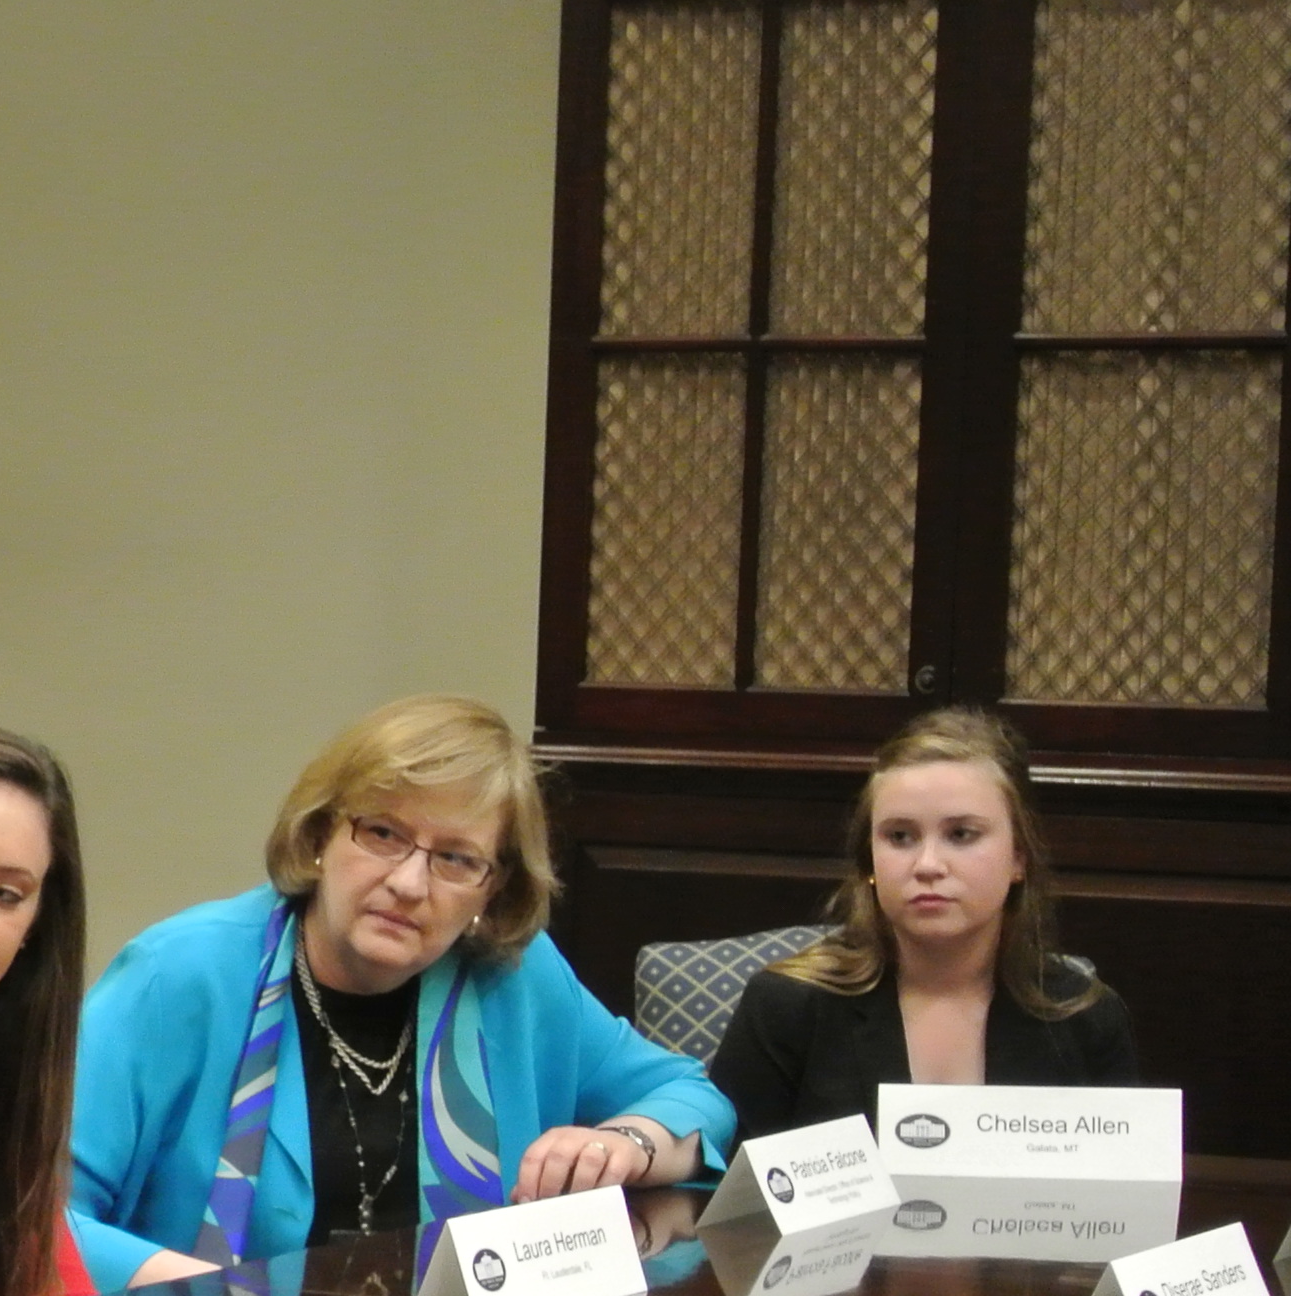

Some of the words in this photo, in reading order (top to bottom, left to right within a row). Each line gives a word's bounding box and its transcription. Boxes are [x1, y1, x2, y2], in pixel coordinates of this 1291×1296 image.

[976, 1113, 1068, 1134] Chelsea
[1074, 1115, 1130, 1135] Allen
[1063, 1144, 1079, 1153] MT
[790, 1155, 829, 1180] Patricia
[826, 1149, 868, 1171] Falcone
[513, 1239, 553, 1262] Laura
[553, 1227, 607, 1253] Herman
[1201, 1264, 1246, 1291] Sanders
